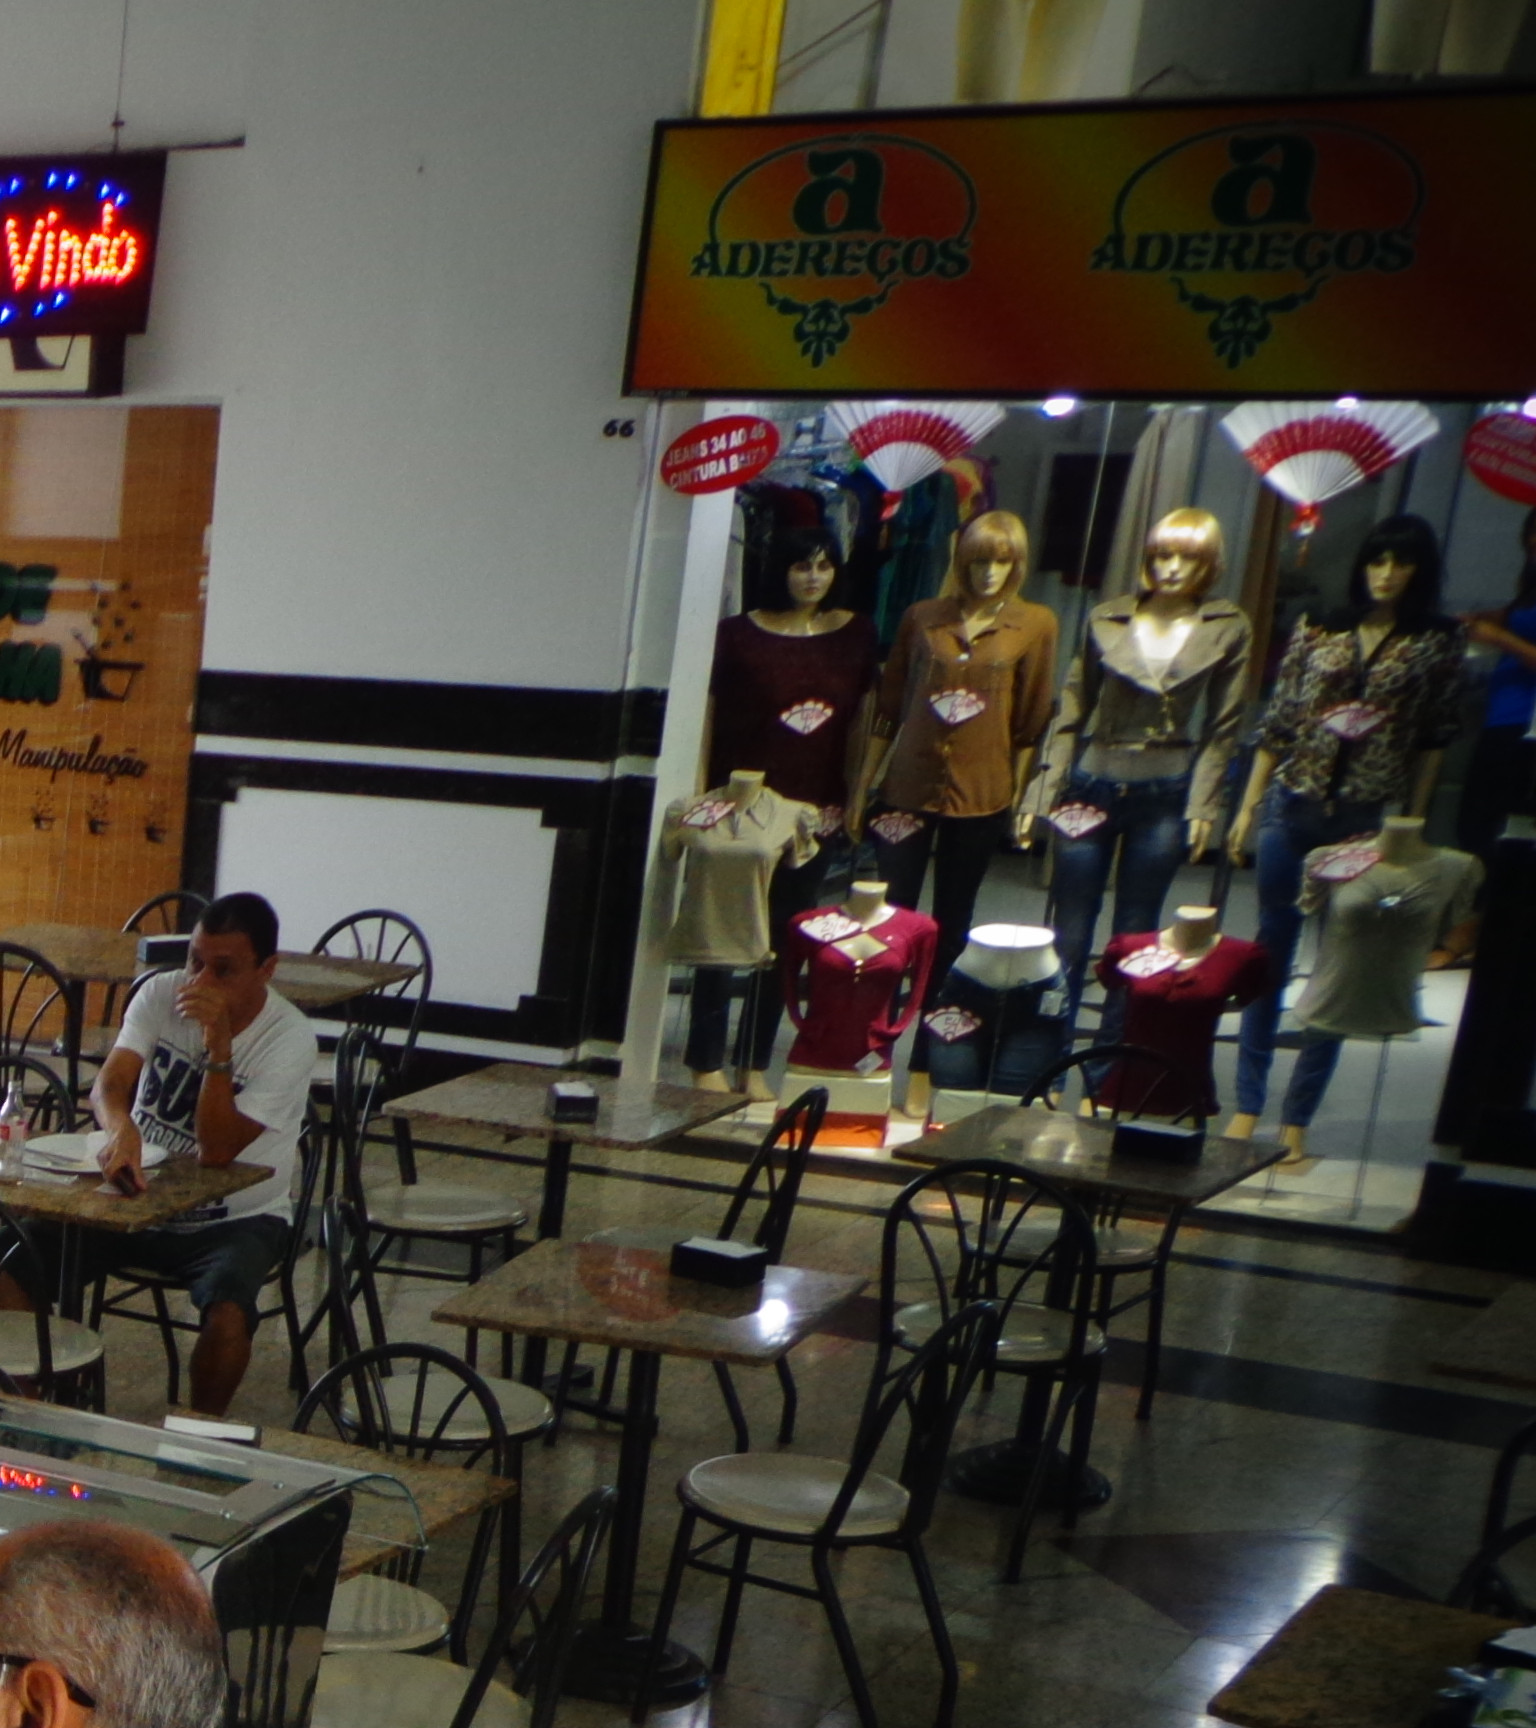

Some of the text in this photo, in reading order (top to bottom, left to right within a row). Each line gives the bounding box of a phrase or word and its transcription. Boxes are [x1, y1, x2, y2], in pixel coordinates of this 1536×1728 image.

[5, 200, 139, 291] Vindo
[689, 237, 973, 284] ADEREÇOS
[602, 418, 636, 438] 66
[711, 433, 727, 454] 34
[730, 427, 747, 448] AO
[669, 461, 727, 490] CINTURA
